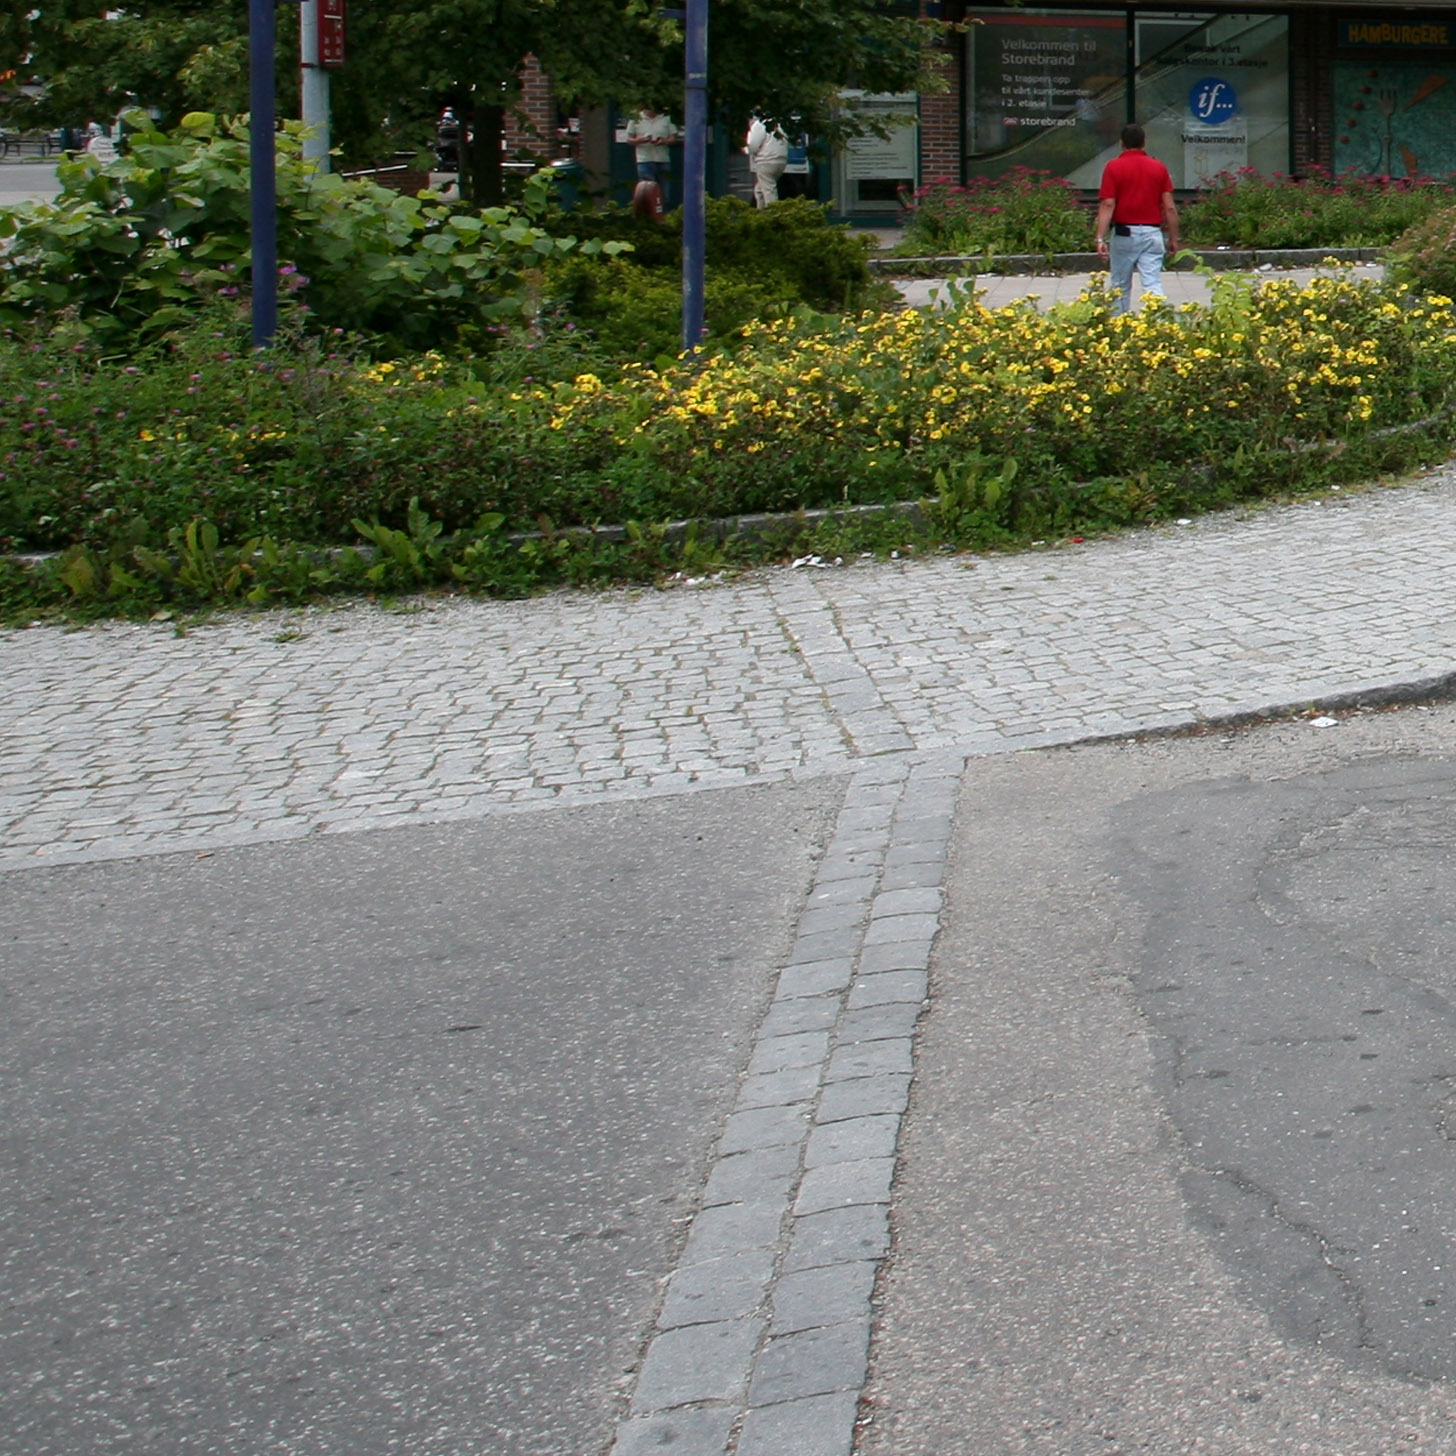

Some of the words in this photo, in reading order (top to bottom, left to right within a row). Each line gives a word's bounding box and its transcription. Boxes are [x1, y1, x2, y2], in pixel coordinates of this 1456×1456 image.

[1347, 23, 1449, 45] HAMBURGERE
[1001, 39, 1079, 51] Velkommen
[1083, 41, 1097, 52] til
[1001, 53, 1076, 66] Storebrand
[1001, 74, 1013, 83] Ta
[1020, 116, 1077, 127] storebrand
[1181, 134, 1246, 144] Velkommen!
